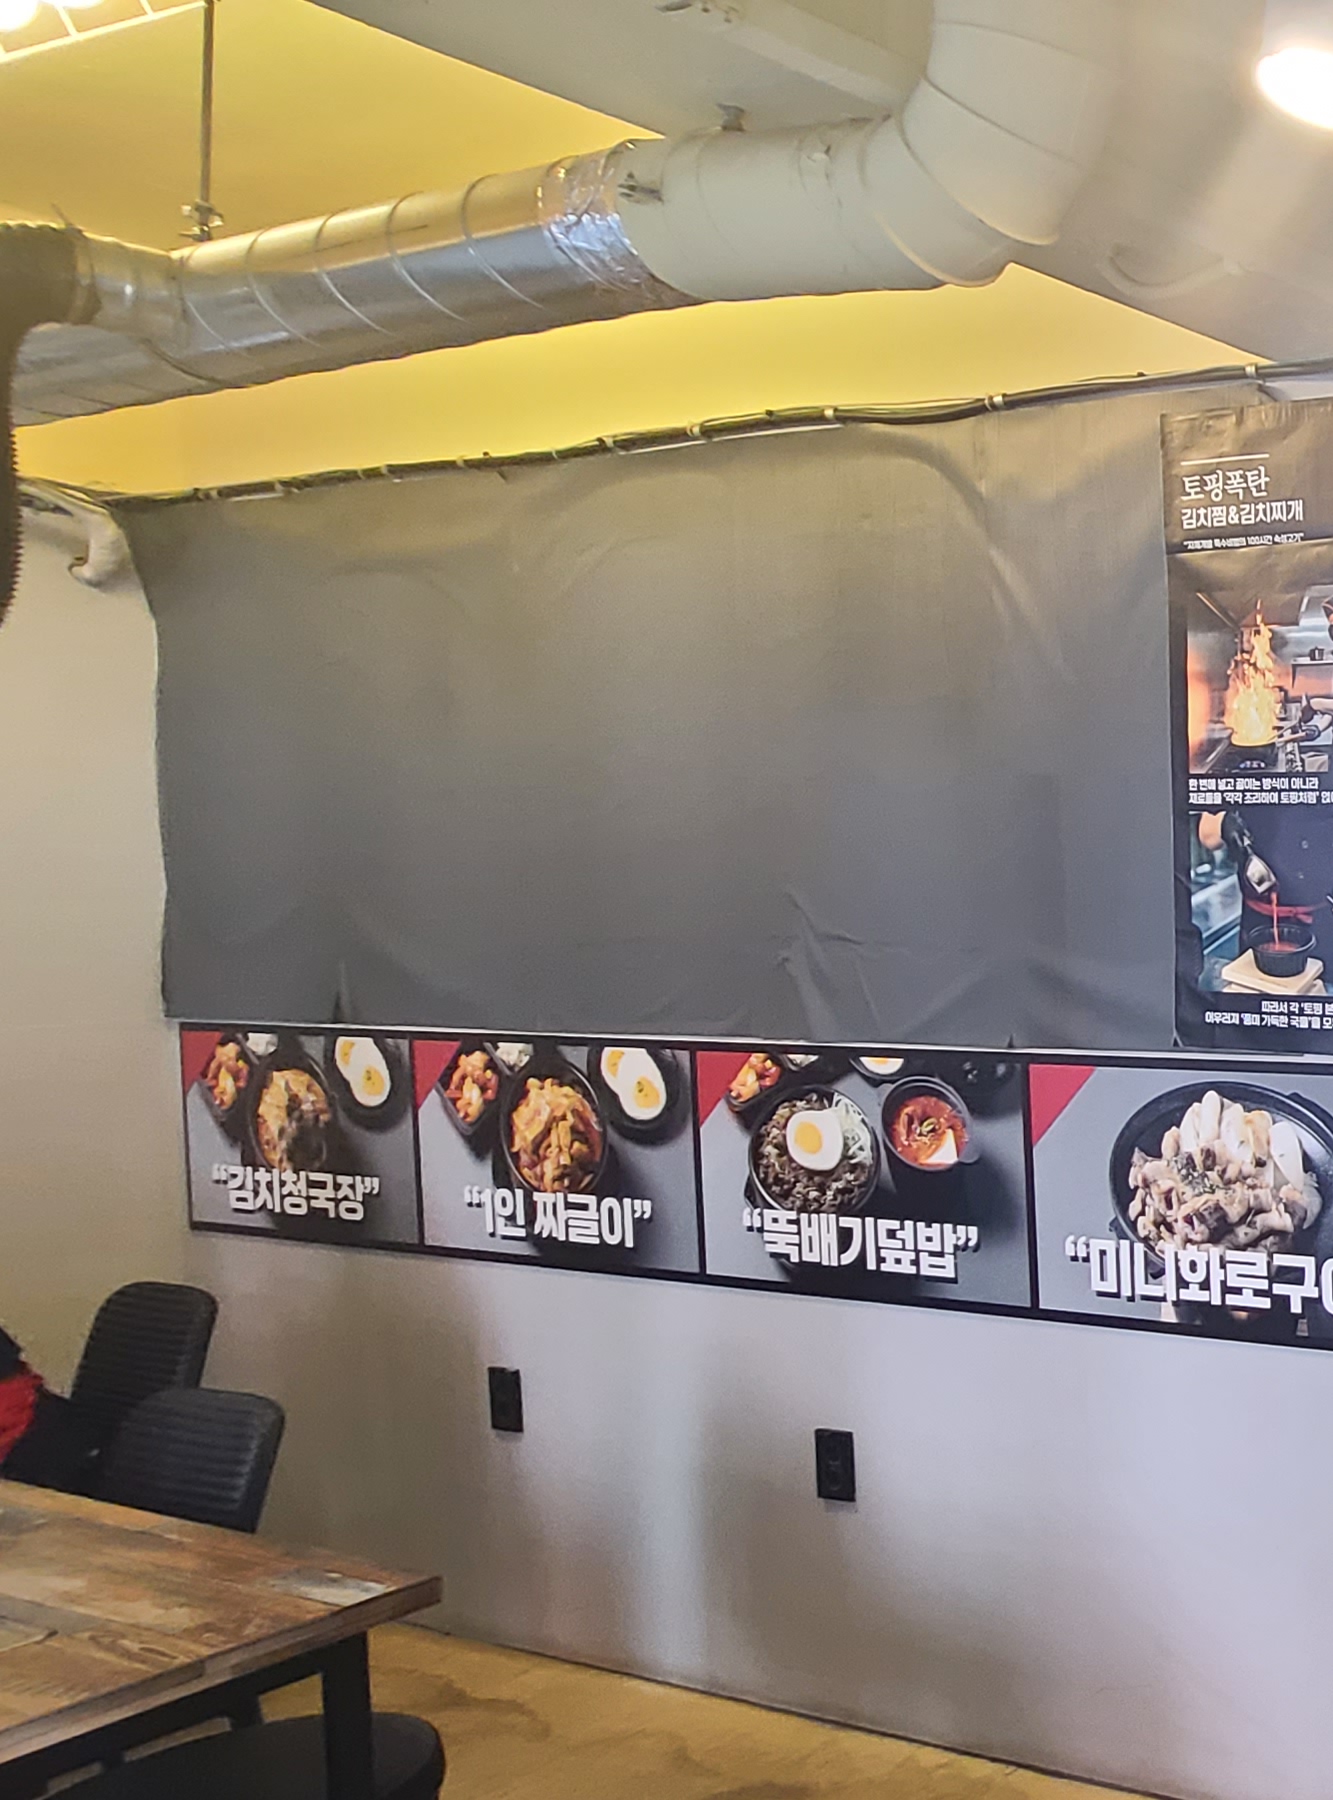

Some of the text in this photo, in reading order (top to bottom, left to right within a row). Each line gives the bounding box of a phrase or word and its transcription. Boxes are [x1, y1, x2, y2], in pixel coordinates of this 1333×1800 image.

[1180, 466, 1270, 502] 토핑폭탄
[1182, 500, 1303, 529] 김치찜&김치찌개
[1262, 778, 1288, 790] 방식이
[1290, 777, 1319, 790] 아니라
[1289, 1002, 1300, 1014] 각
